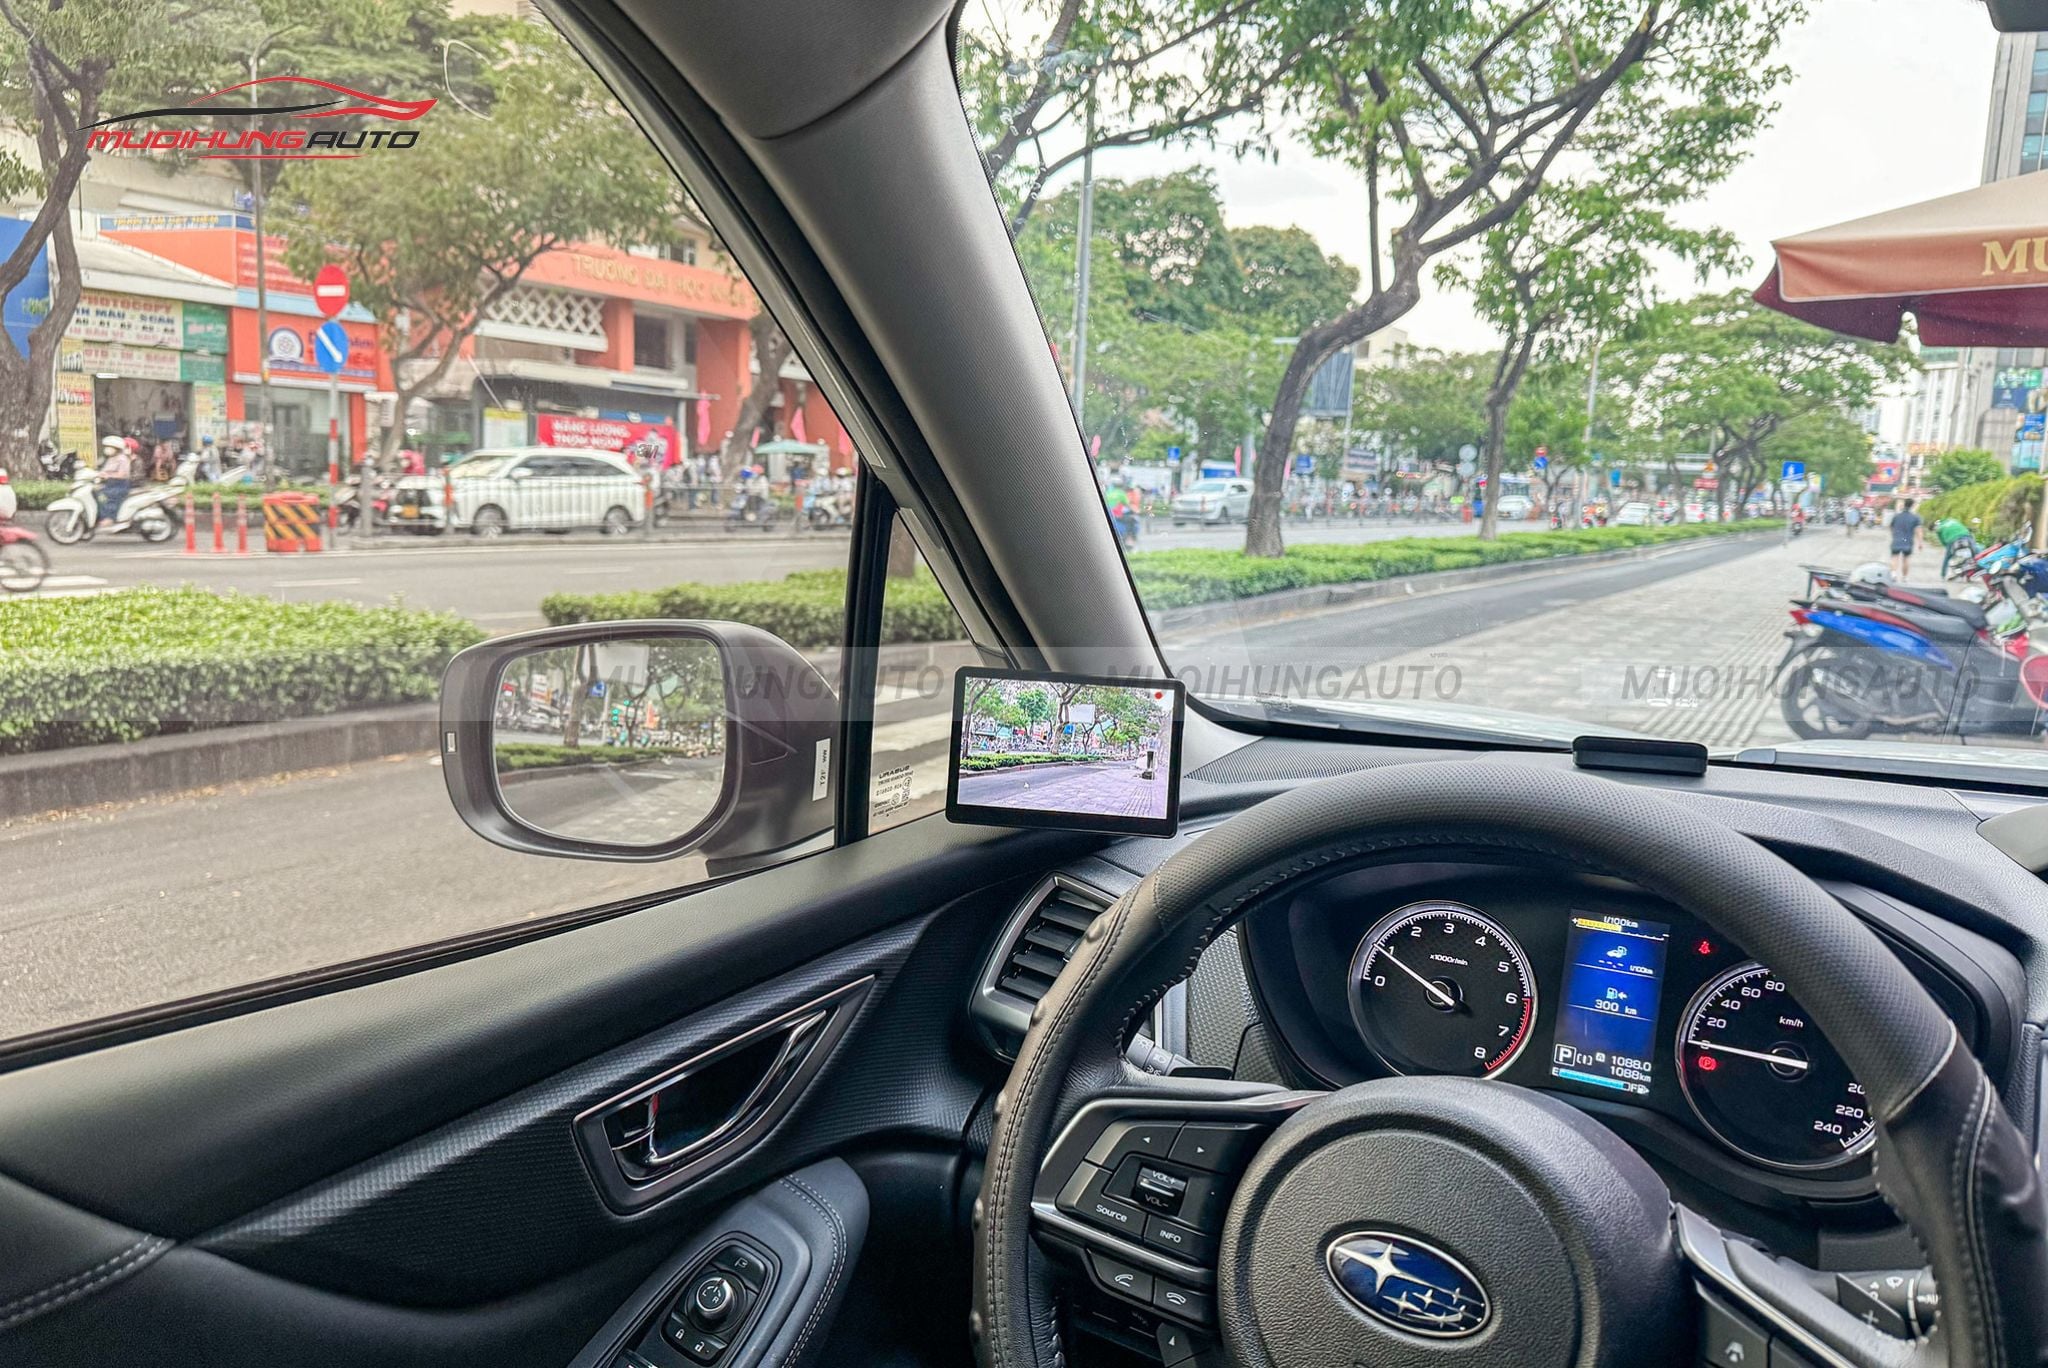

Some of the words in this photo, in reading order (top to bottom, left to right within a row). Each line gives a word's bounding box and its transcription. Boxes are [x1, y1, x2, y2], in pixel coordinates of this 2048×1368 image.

[1411, 926, 1422, 938] 2
[1443, 923, 1455, 934] 3
[1475, 936, 1486, 947] 4
[1497, 961, 1510, 973] 5
[1374, 976, 1385, 987] 0
[1764, 980, 1785, 992] 80
[1741, 986, 1761, 998] 60
[1505, 993, 1518, 1004] 6
[1720, 999, 1741, 1010] 40
[1594, 999, 1619, 1012] 300
[1624, 1006, 1637, 1015] km
[1706, 1017, 1727, 1029] 20
[1779, 1016, 1804, 1028] km/h
[1498, 1025, 1510, 1036] 7
[1474, 1047, 1486, 1058] 8
[1611, 1055, 1652, 1072] 1088.0
[1847, 1083, 1866, 1095] 20
[1835, 1104, 1864, 1119] 220
[1813, 1120, 1842, 1135] 240
[1159, 1230, 1182, 1244] INFO
